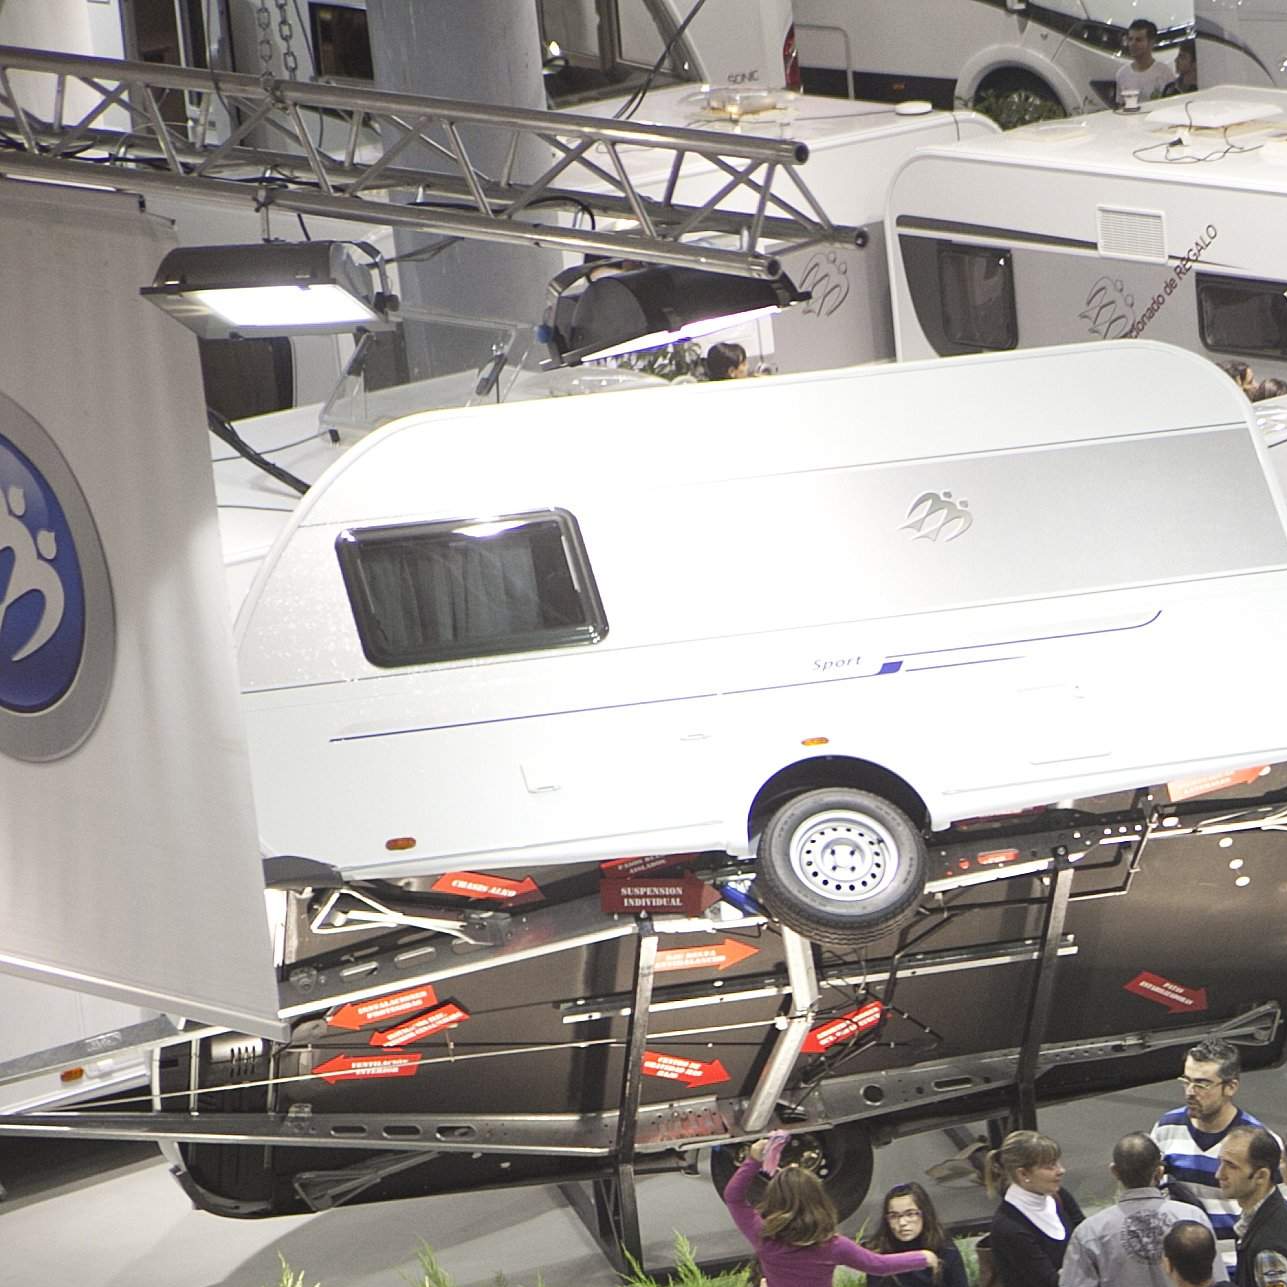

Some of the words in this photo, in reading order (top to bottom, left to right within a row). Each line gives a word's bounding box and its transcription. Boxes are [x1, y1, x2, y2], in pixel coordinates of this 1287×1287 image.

[1173, 223, 1218, 281] REGALO
[813, 655, 863, 672] Sport
[620, 886, 683, 896] SUSPENSION
[623, 897, 683, 907] INDIVIDUAL
